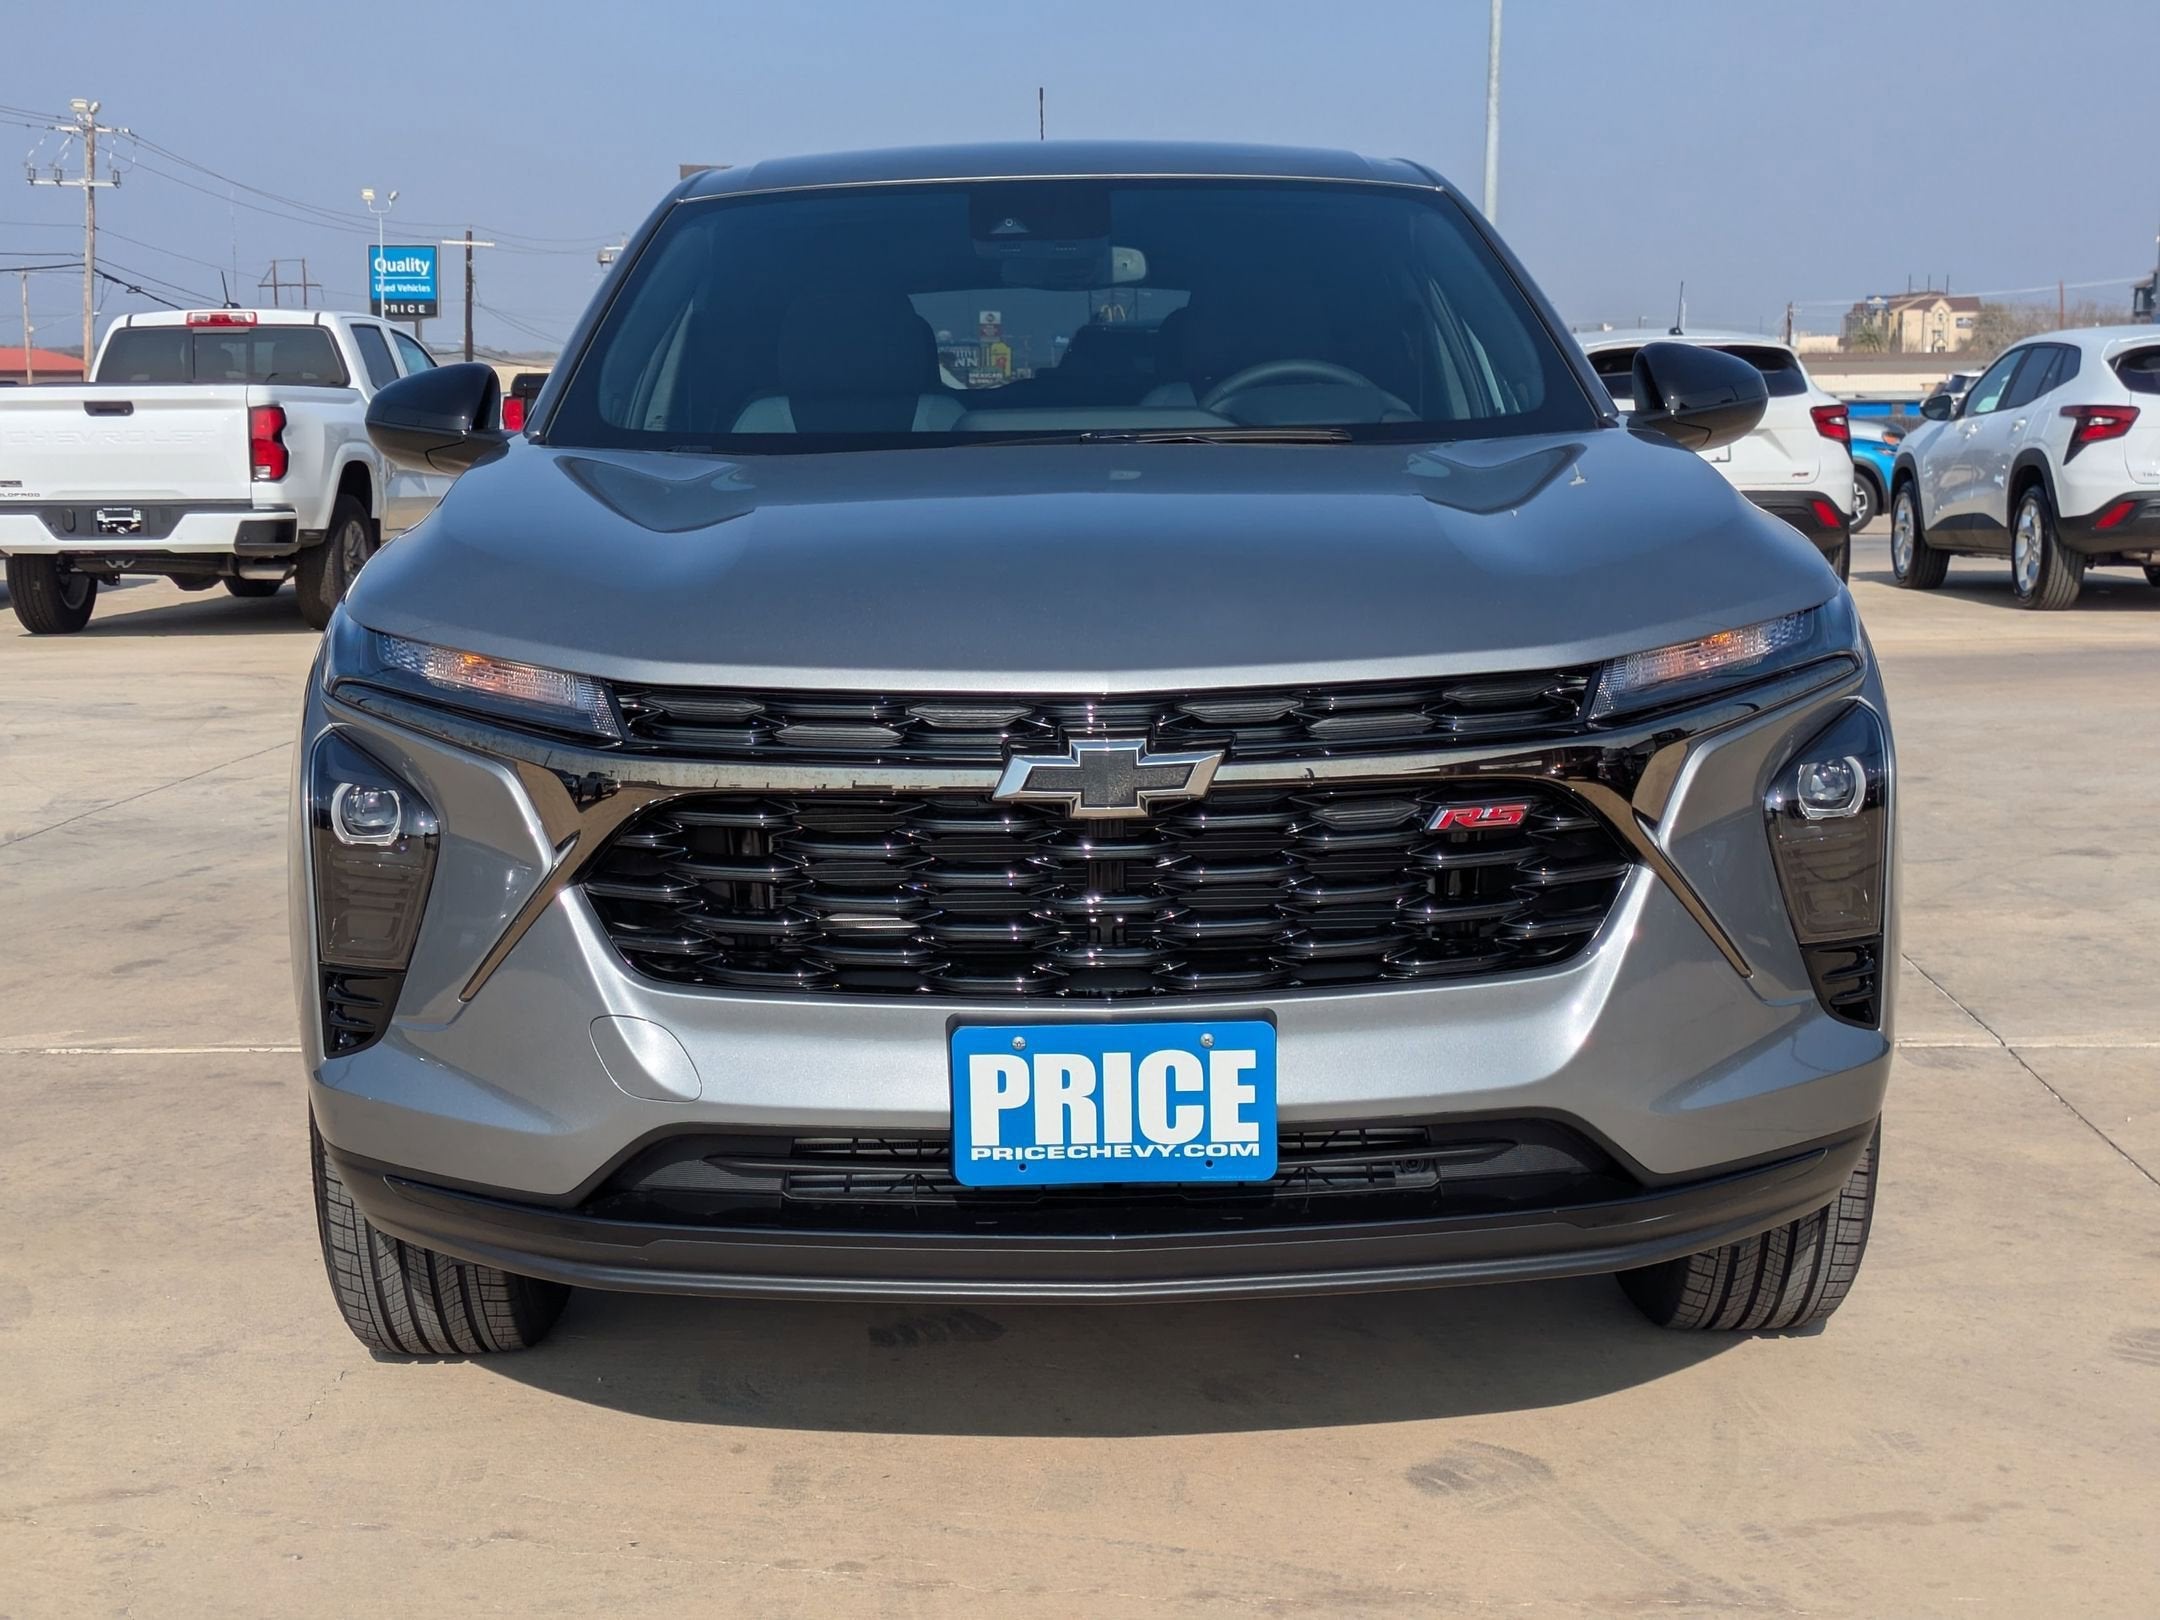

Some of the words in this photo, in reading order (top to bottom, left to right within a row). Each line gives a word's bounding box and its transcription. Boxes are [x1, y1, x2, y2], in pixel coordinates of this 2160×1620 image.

[374, 257, 430, 276] Quality
[397, 283, 431, 293] Vehicles
[6, 430, 215, 446] CHEVROLET
[1428, 804, 1527, 830] RS
[968, 1049, 1260, 1147] PRICE
[970, 1143, 1260, 1161] PRICECHEVY.COM
